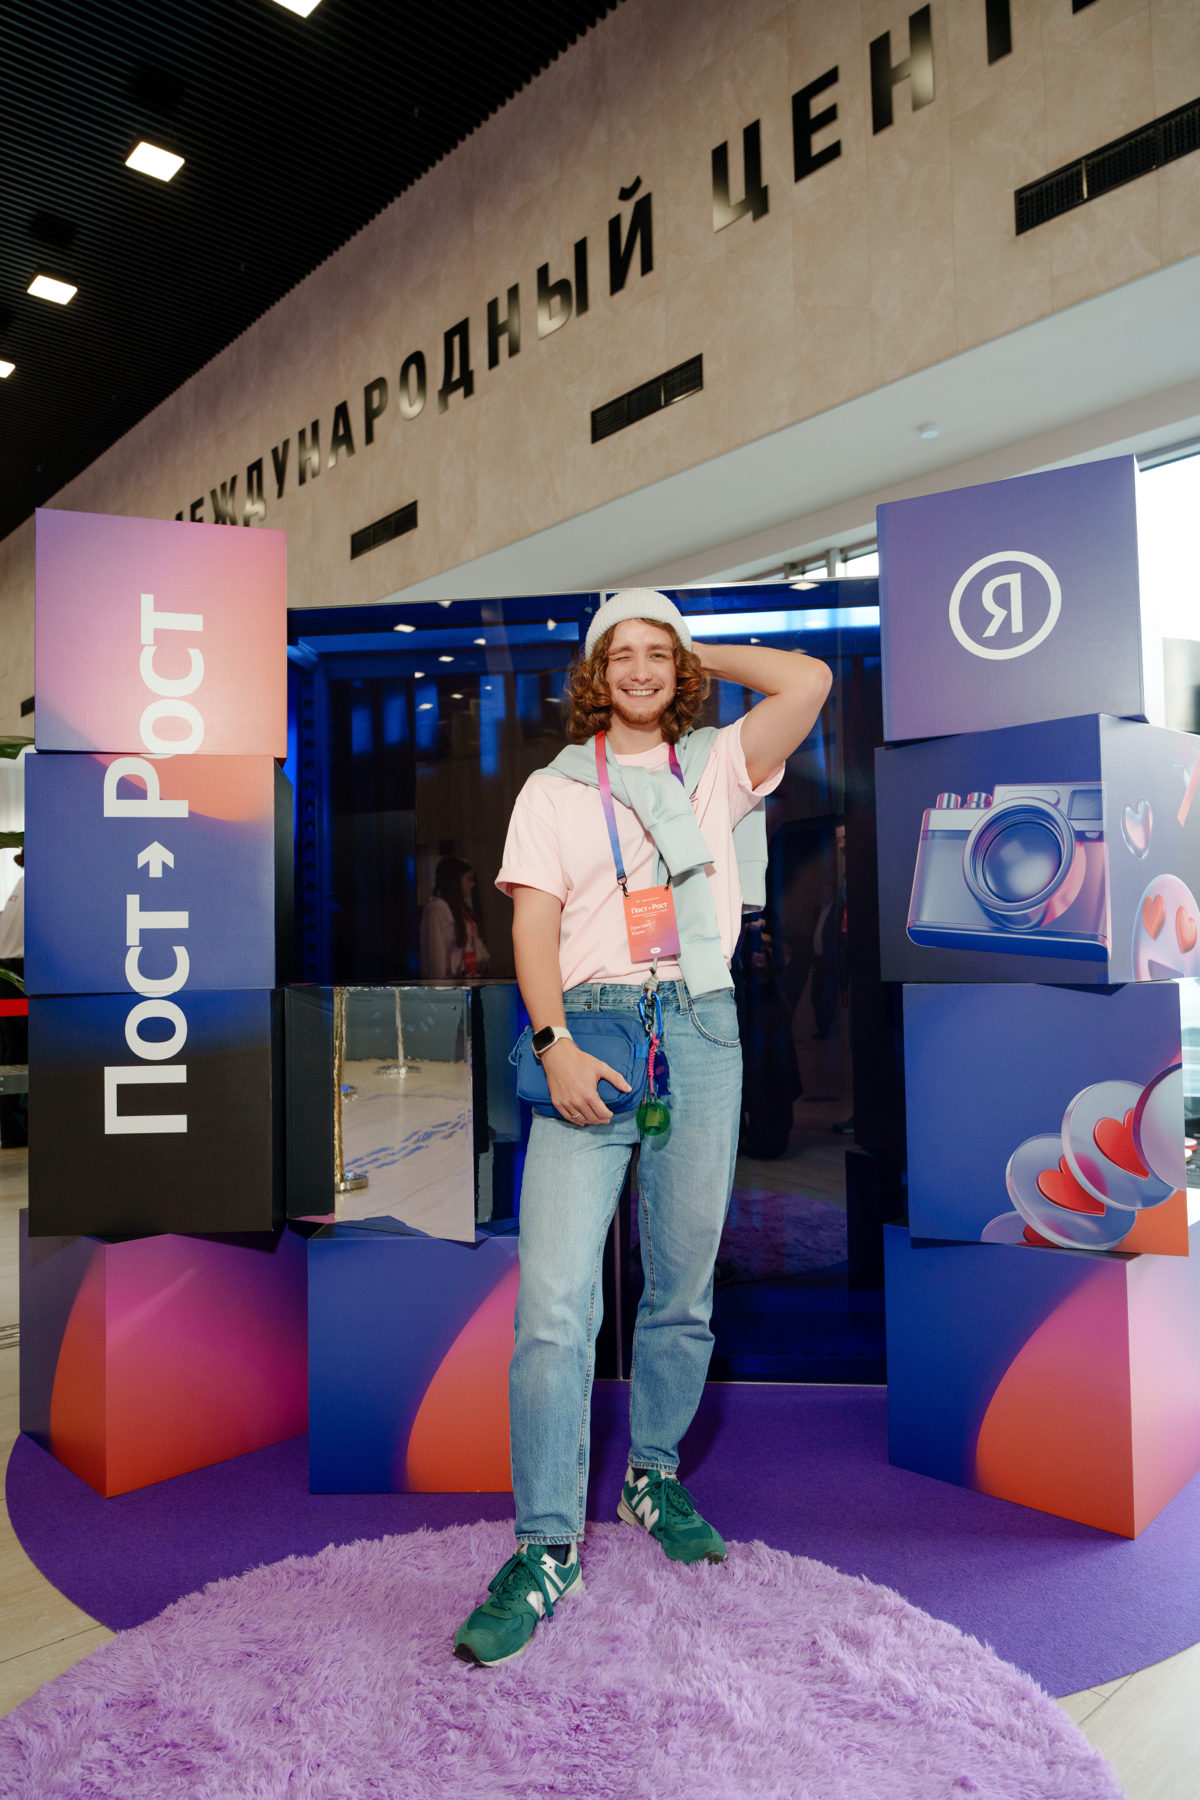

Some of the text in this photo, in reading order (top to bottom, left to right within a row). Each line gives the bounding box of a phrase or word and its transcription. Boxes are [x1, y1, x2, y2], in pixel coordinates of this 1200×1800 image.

[175, 0, 1099, 527] ЕЖДУНАРОДНЫЙ ЦЕН
[103, 593, 204, 1134] Пост Рост
[631, 906, 648, 914] Пост
[652, 902, 668, 910] Рост
